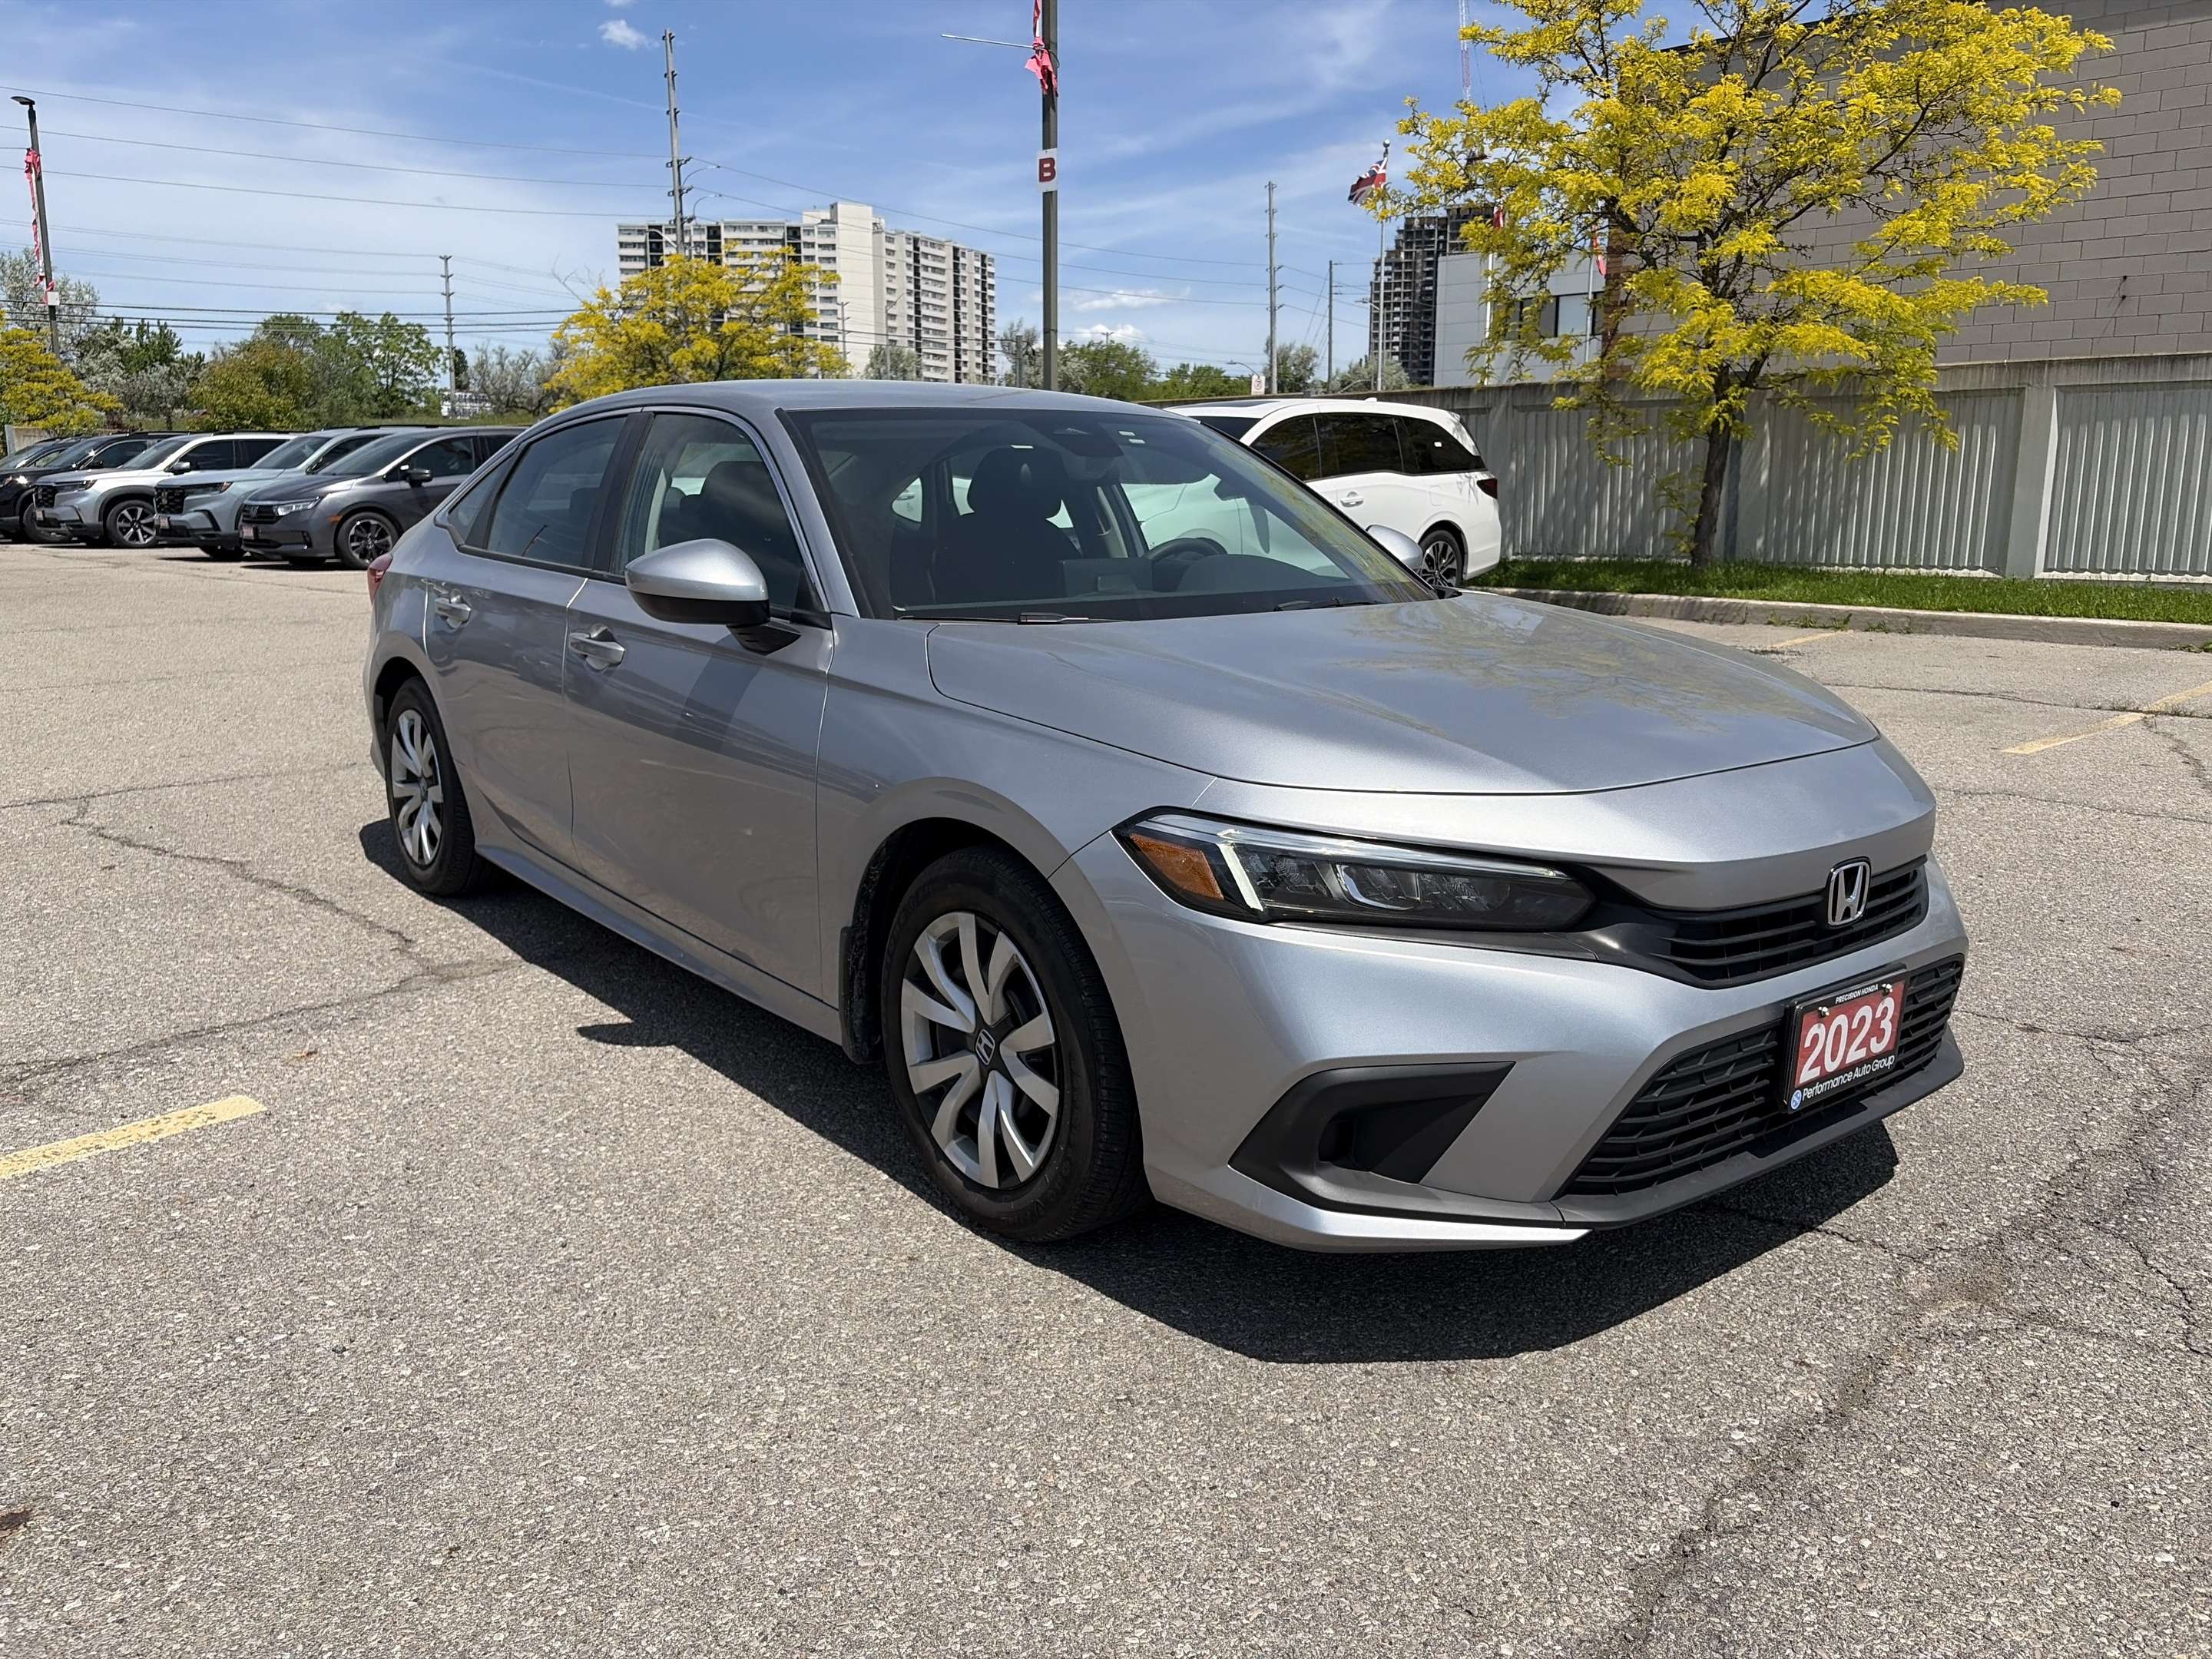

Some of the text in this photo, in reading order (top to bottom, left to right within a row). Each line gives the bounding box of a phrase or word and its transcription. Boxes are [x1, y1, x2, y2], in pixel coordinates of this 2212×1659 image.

[1038, 157, 1056, 183] B
[1835, 983, 1879, 1005] PRECISION HONDA
[1799, 996, 1895, 1084] 2023
[1802, 1055, 1896, 1101] Performance Auto Group
